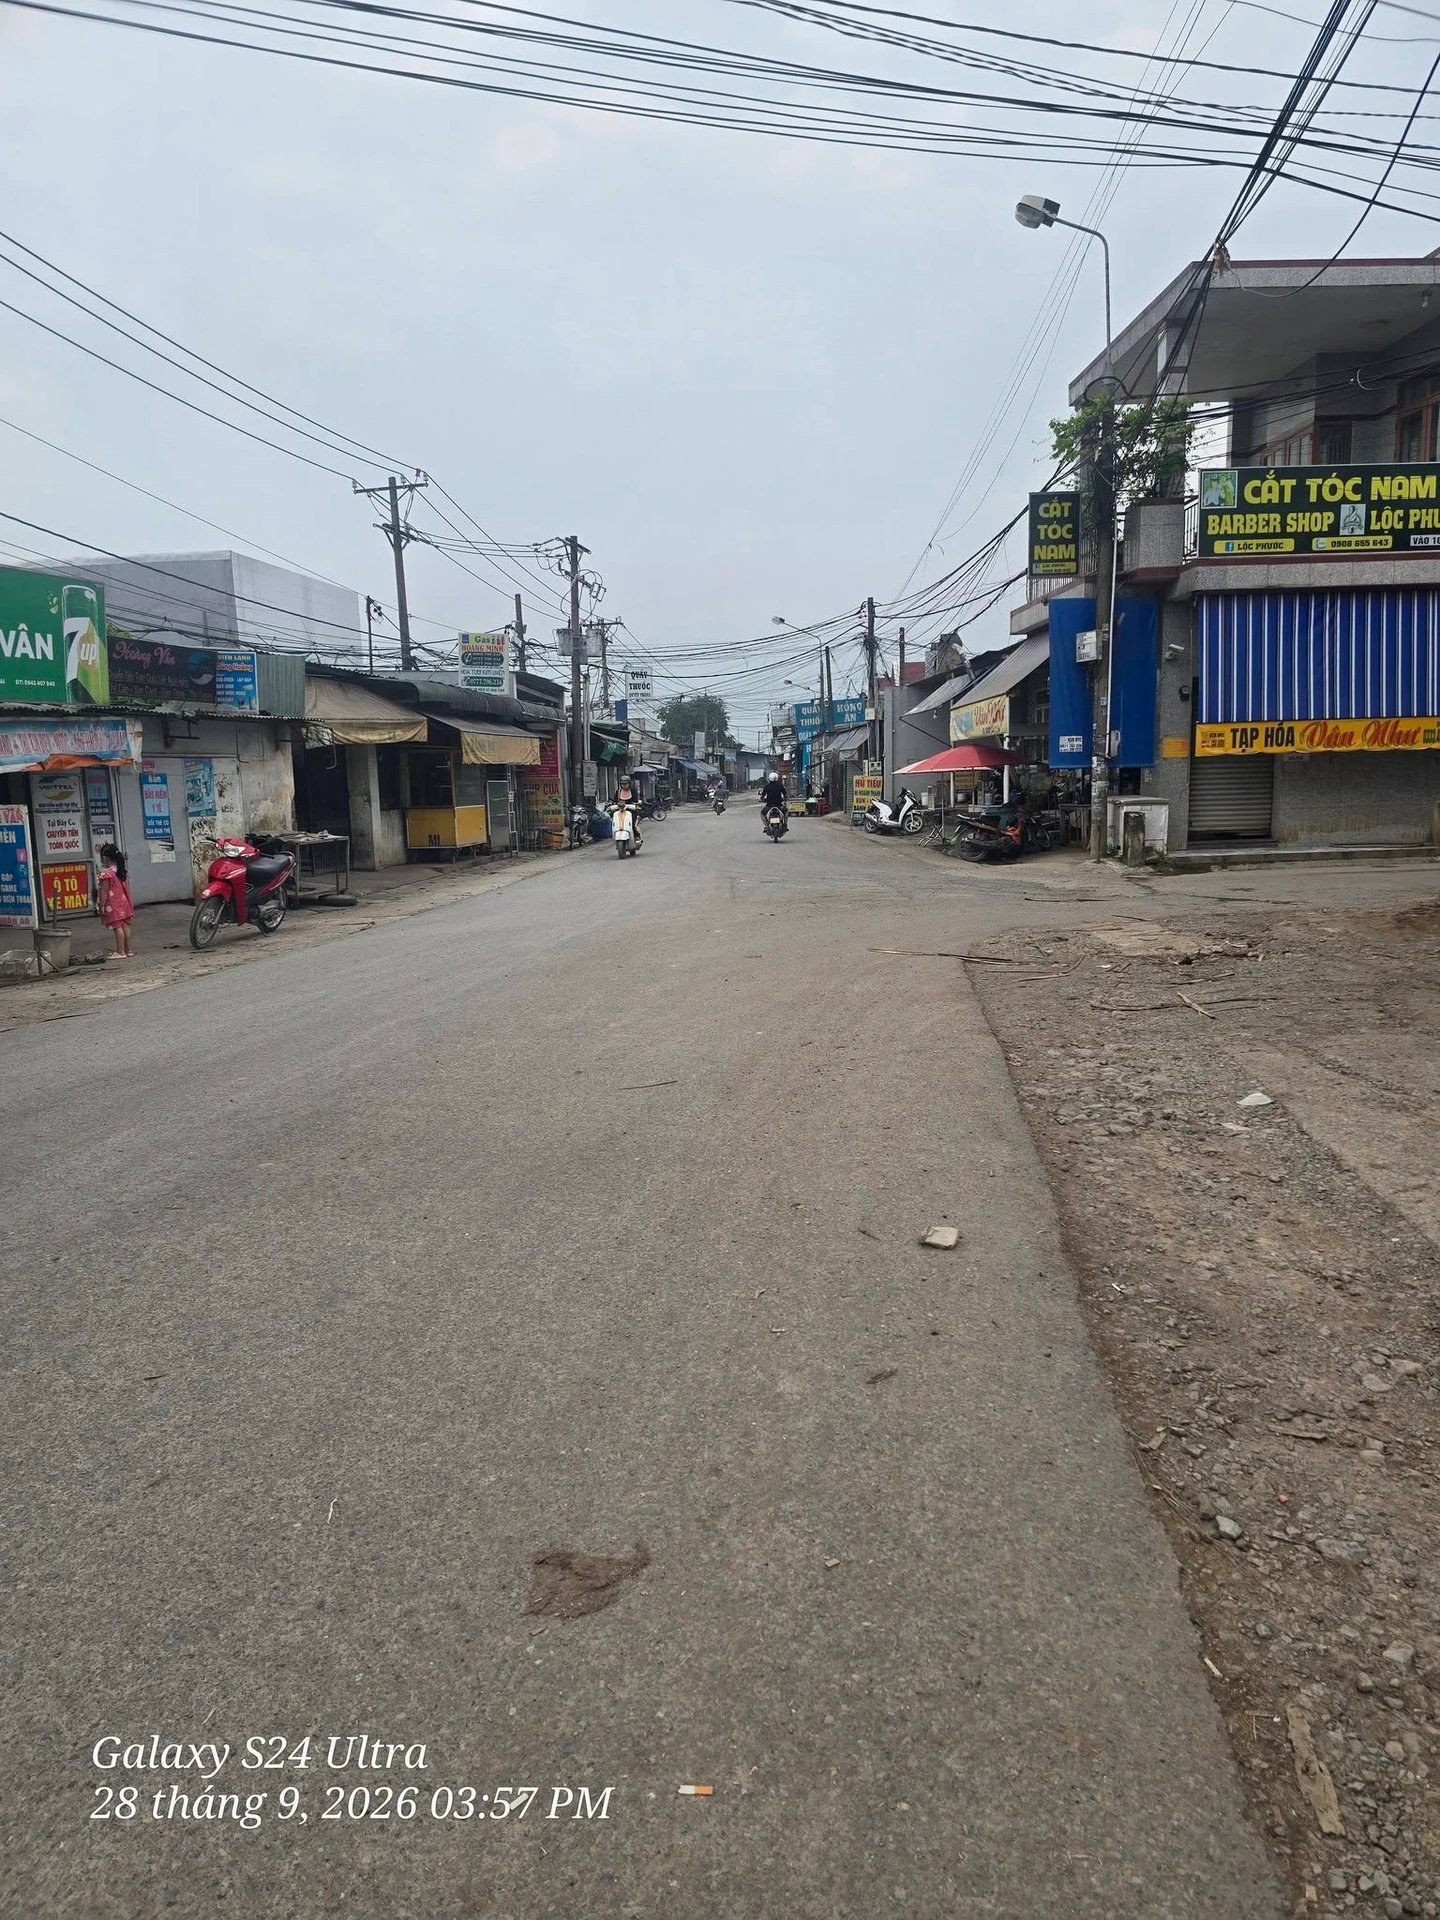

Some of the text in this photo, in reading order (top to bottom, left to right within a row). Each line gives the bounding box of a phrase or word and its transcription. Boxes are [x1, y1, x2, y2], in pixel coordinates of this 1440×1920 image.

[1243, 469, 1437, 504] CẮT TÓC NAM
[1038, 496, 1072, 518] CẮT
[1207, 513, 1282, 535] BARBER
[1286, 510, 1335, 533] SHOP
[1369, 506, 1404, 534] LỘC
[1037, 521, 1073, 540] TÓC
[1237, 541, 1284, 552] LỘC PHƯỚC
[1331, 538, 1389, 548] 0908 655 643
[1412, 535, 1430, 545] VÀO
[1034, 544, 1076, 560] NAM
[0, 623, 54, 661] VÂN
[1230, 727, 1259, 753] TẠP
[1264, 722, 1296, 748] HÓA
[1300, 720, 1356, 749] Vân
[1362, 719, 1422, 748] Như
[543, 783, 560, 795] CUA
[63, 875, 78, 891] TÔ
[64, 892, 87, 909] MÁY
